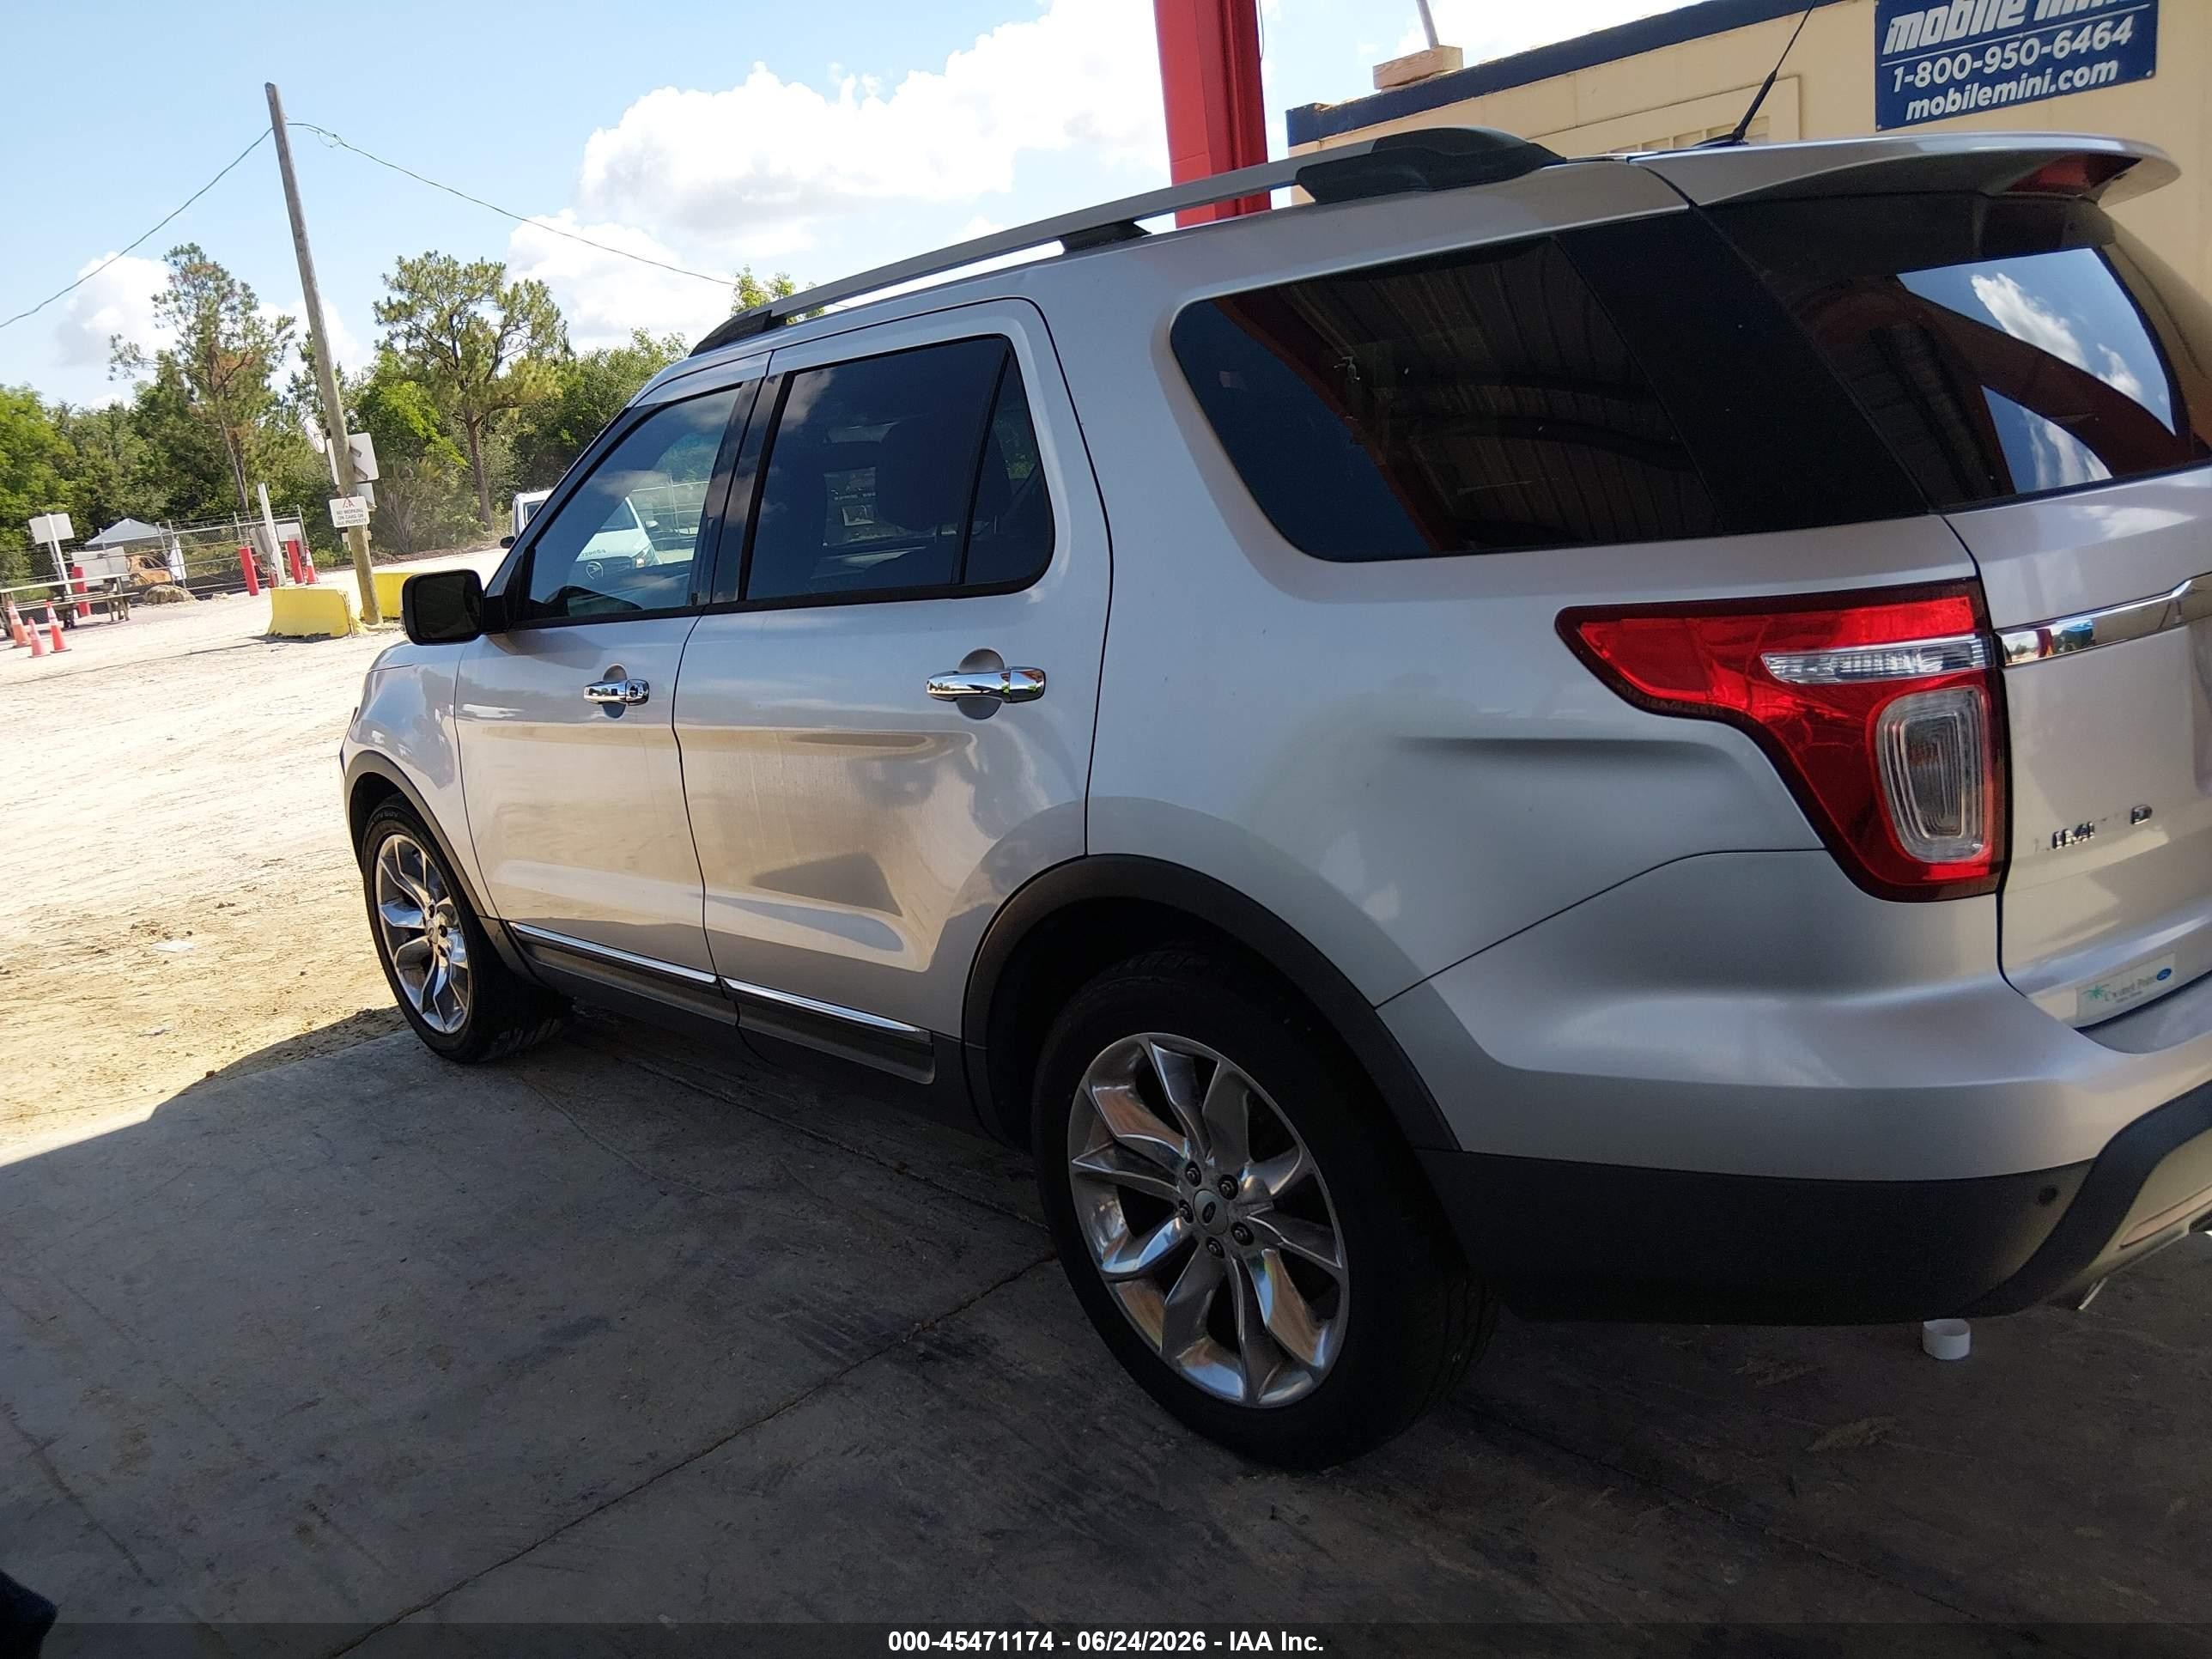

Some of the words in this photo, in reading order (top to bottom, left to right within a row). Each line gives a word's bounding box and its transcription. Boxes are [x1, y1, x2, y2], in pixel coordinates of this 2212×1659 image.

[1881, 0, 2027, 56] mobile
[1893, 15, 2135, 94] 1-800-950-6464
[1905, 59, 2119, 121] mobilemini.com
